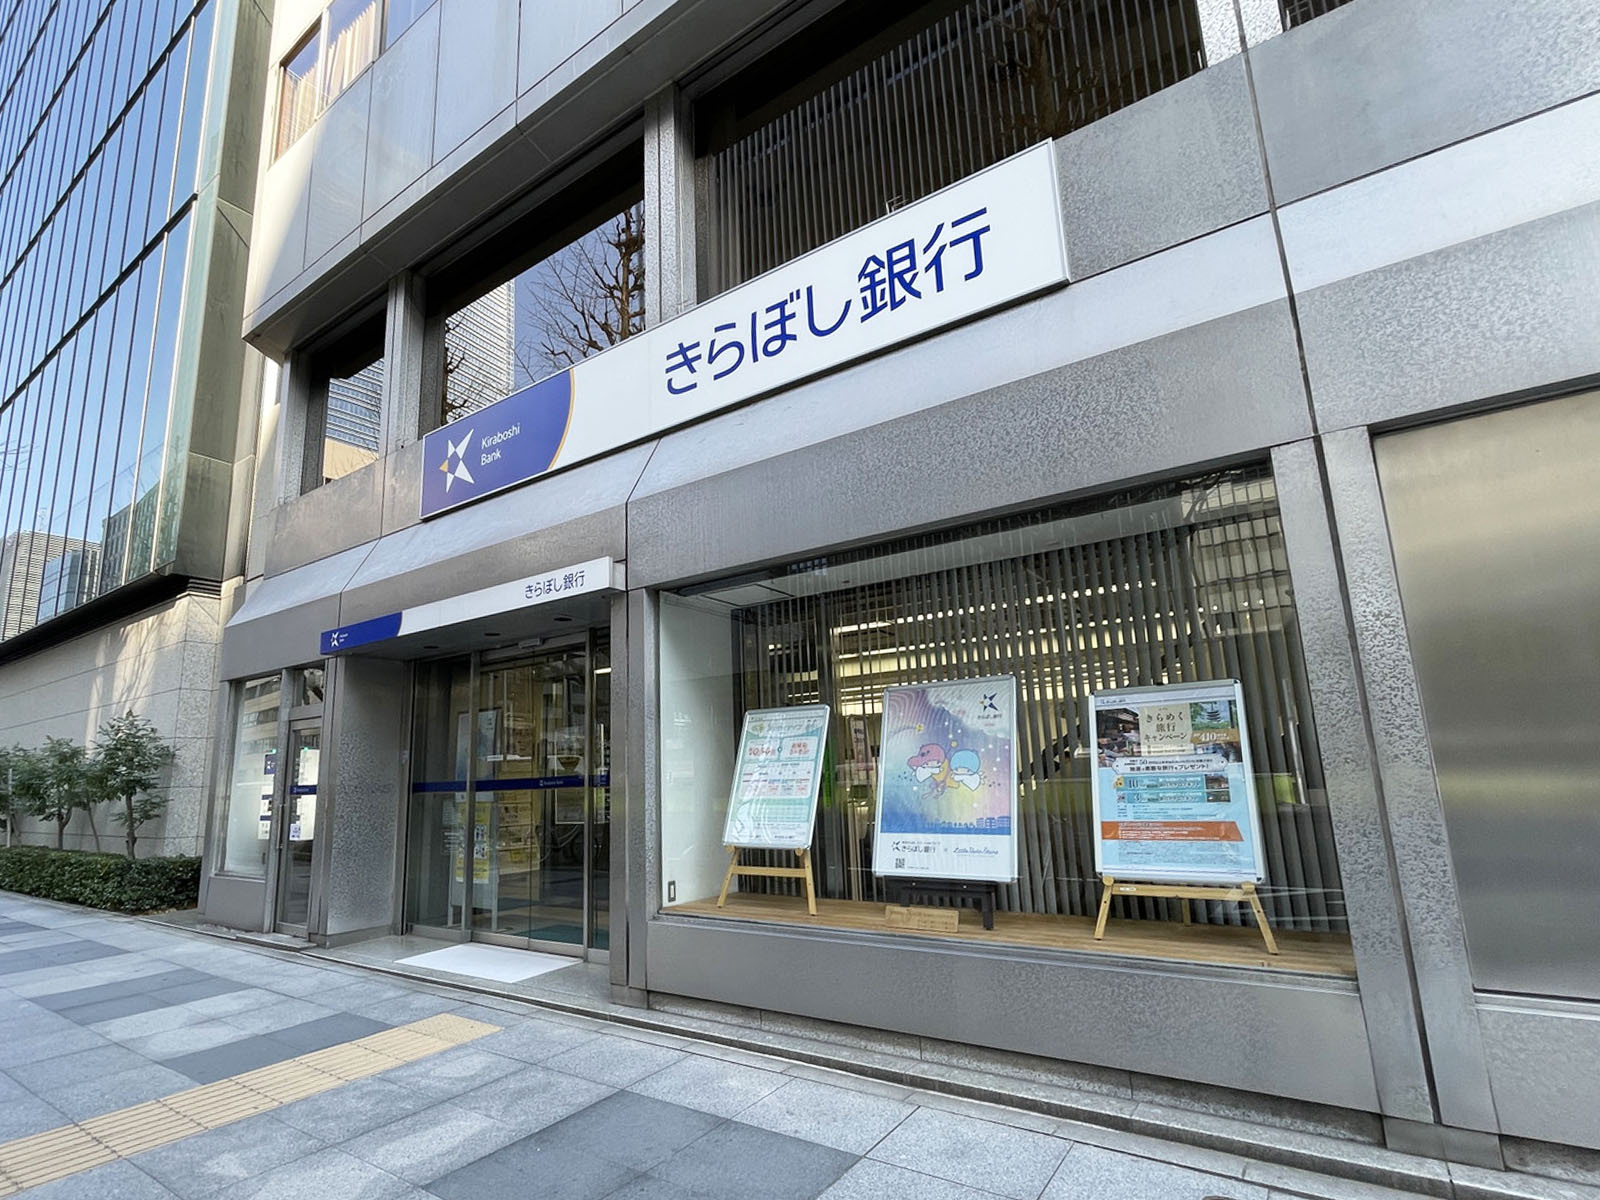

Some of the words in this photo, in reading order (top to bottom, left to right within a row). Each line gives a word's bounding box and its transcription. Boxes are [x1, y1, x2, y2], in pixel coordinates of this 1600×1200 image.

[665, 207, 991, 394] きらぼし銀行
[481, 422, 521, 449] Kiraboshi
[481, 448, 502, 466] Bank
[525, 570, 585, 599] きらぼし銀行
[1146, 711, 1184, 723] きらめく
[1144, 732, 1187, 742] キャンペーン
